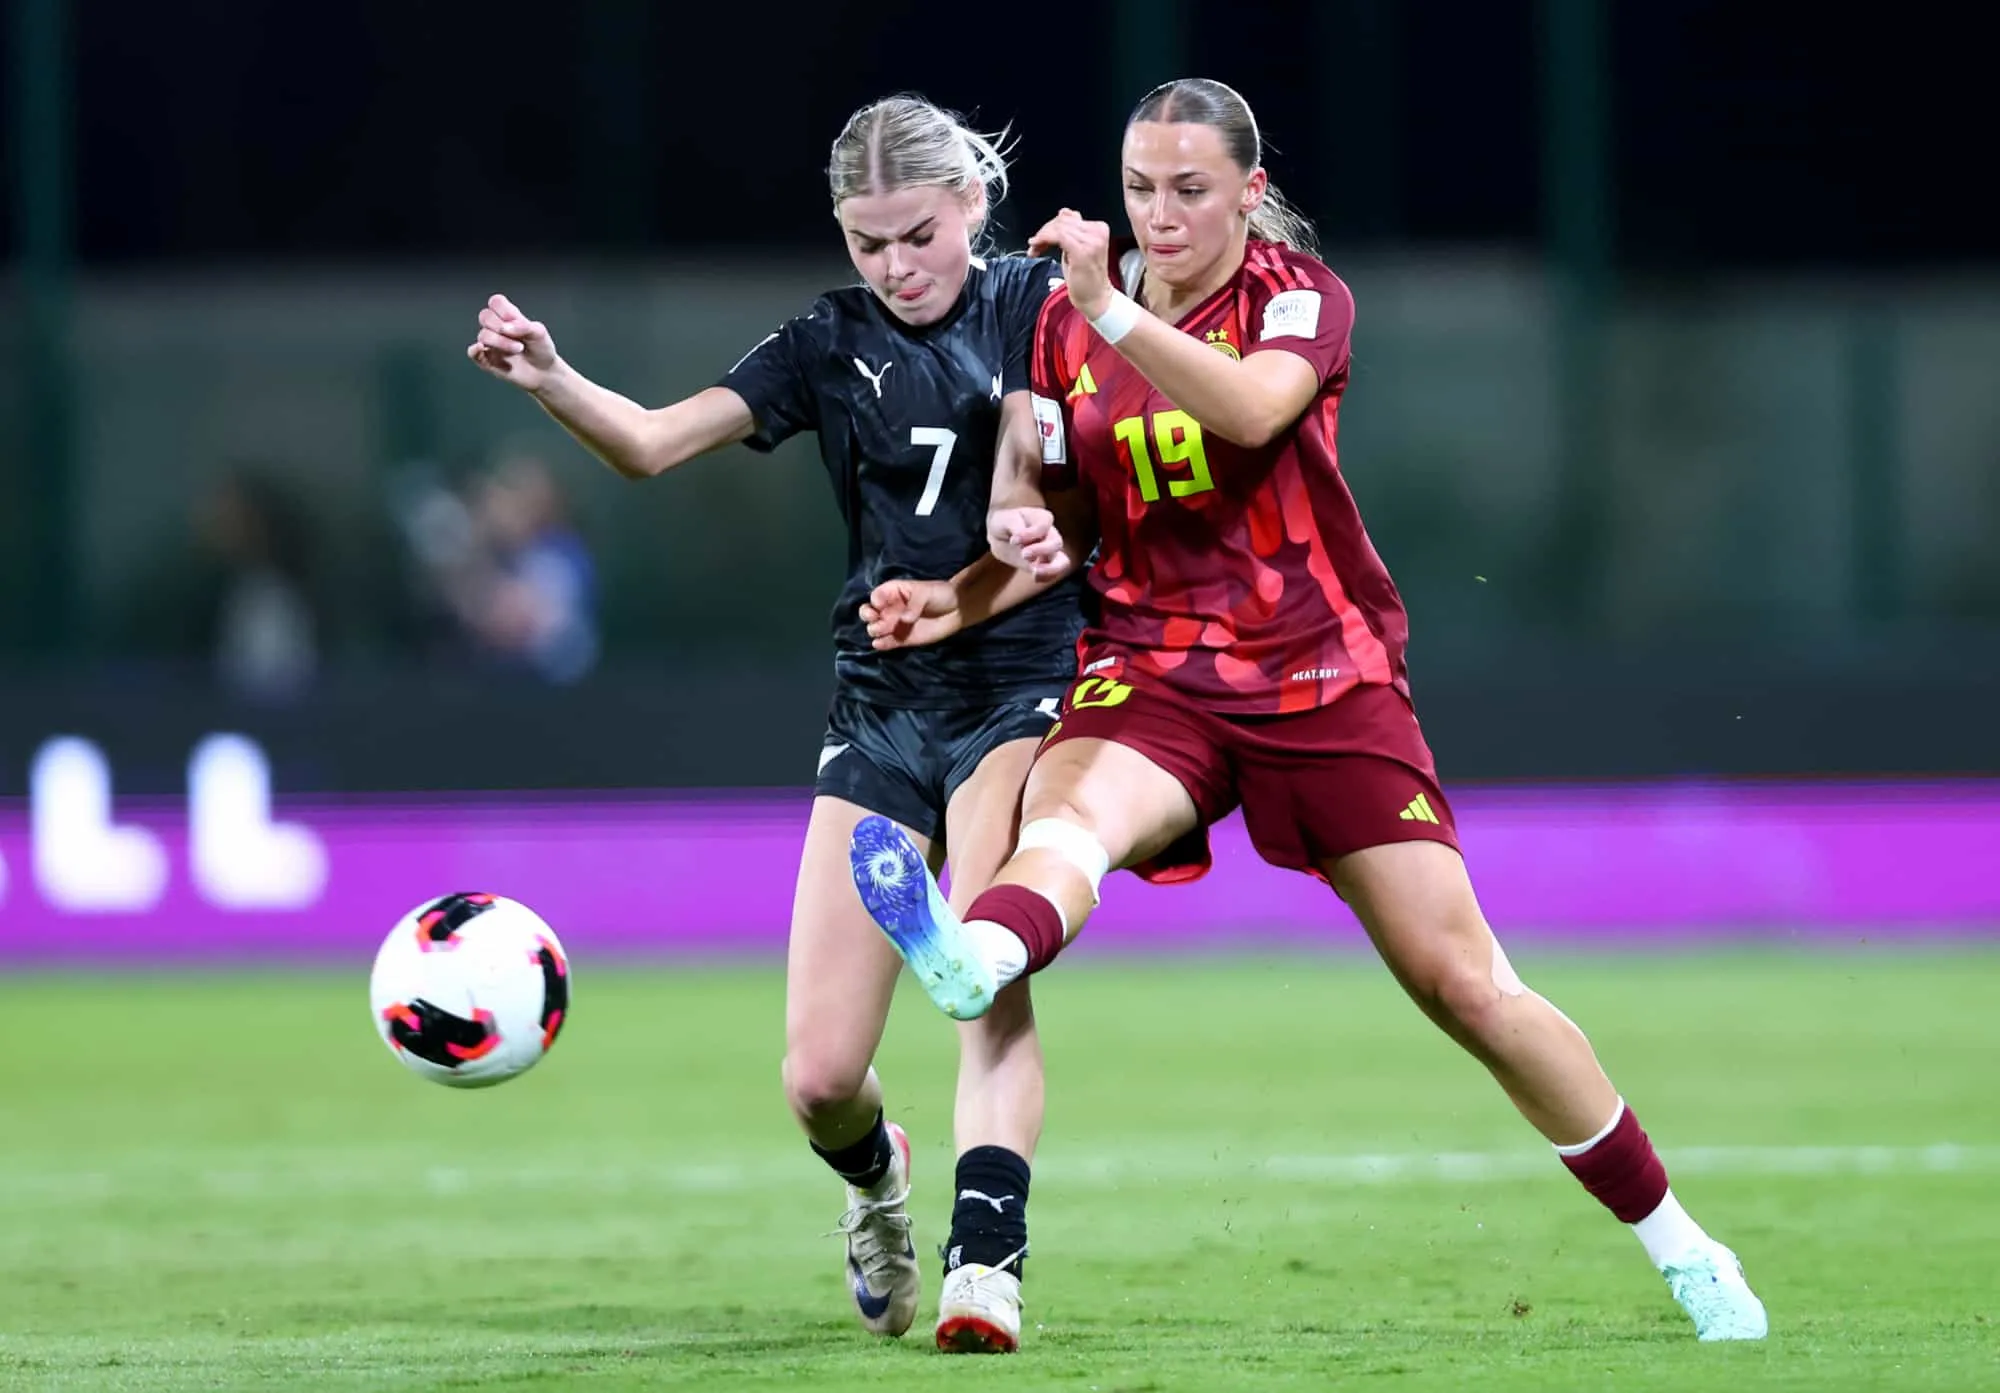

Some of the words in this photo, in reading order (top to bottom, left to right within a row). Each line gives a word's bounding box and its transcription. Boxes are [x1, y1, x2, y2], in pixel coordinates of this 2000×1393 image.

[910, 426, 958, 516] 7
[1113, 408, 1216, 503] 19
[0, 734, 329, 913] LL
